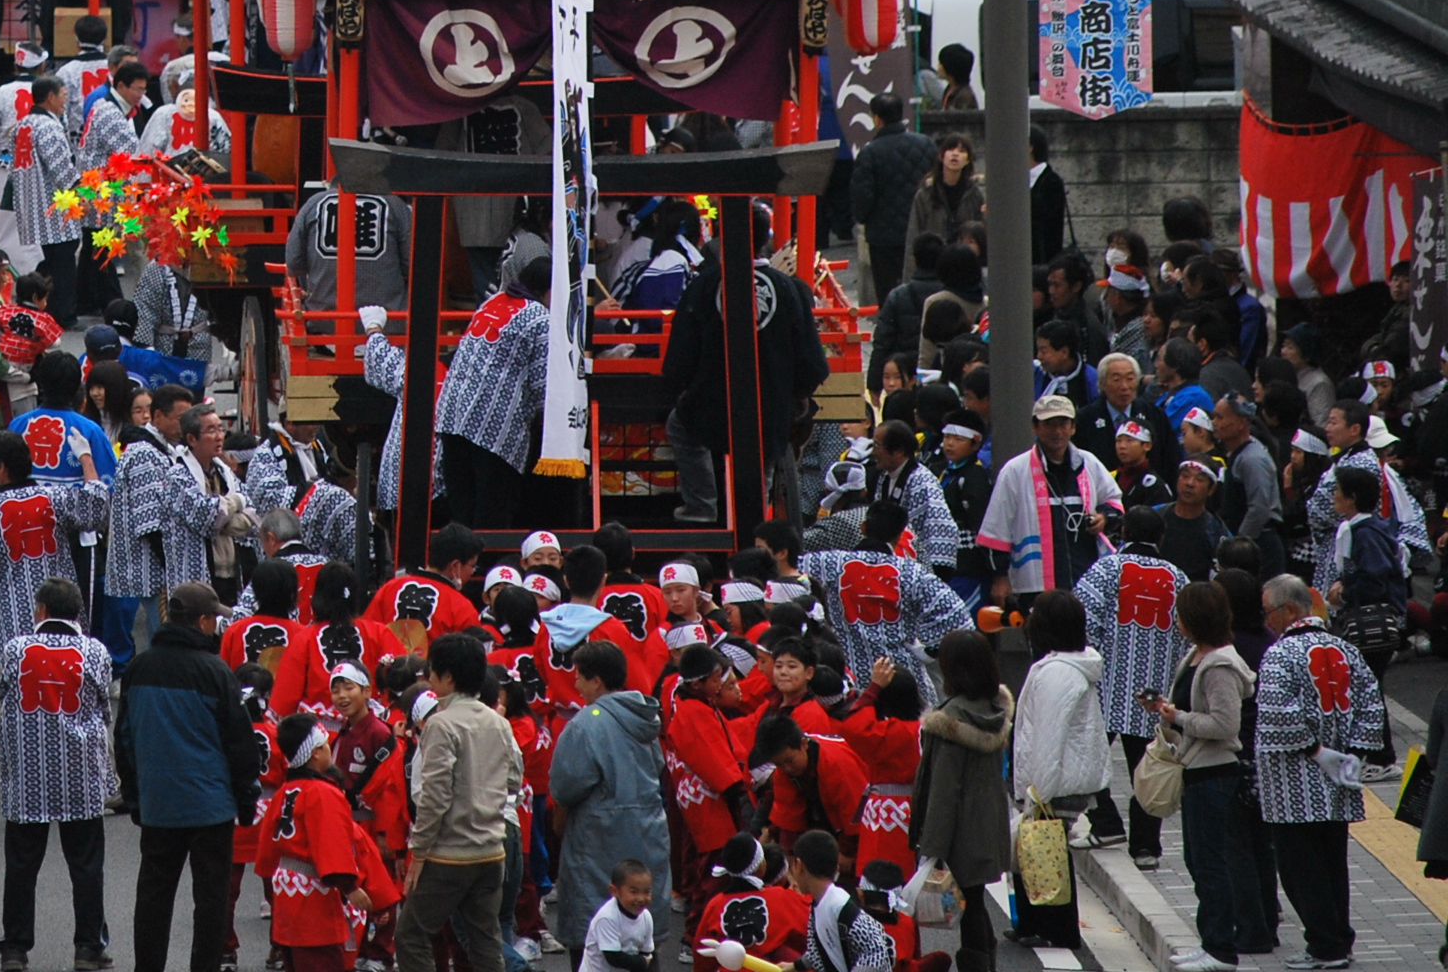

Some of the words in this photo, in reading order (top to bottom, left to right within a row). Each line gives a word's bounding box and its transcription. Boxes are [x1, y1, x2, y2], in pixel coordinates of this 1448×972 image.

[444, 23, 495, 87] 上
[655, 19, 714, 79] 上
[22, 415, 66, 468] 祭
[0, 494, 57, 562] 祭
[838, 560, 902, 626] 祭
[1117, 561, 1176, 632] 祭
[18, 643, 85, 715] 祭
